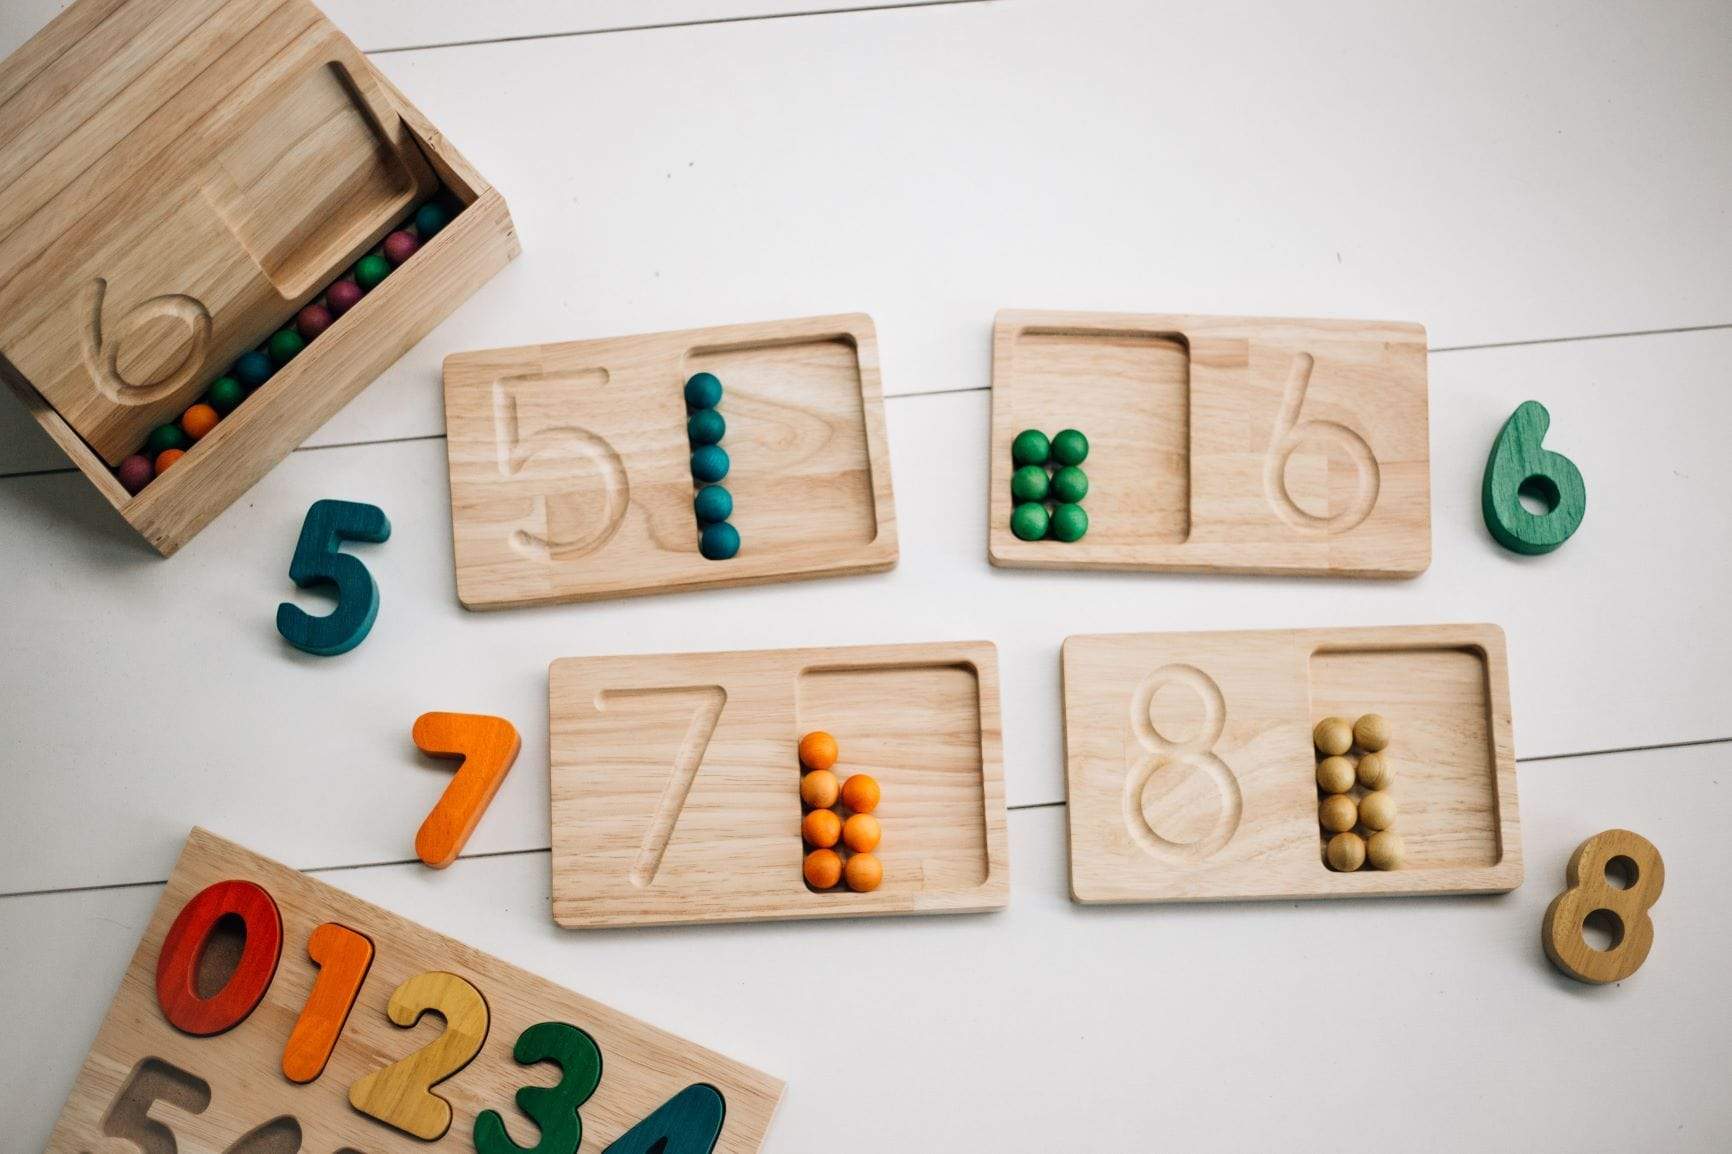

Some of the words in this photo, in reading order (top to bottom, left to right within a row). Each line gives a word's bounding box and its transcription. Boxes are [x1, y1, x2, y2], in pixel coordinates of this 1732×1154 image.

[490, 367, 632, 562] 5
[1262, 351, 1381, 535] 6
[1482, 400, 1586, 556] 6
[276, 499, 391, 656] 5
[412, 711, 522, 870] 7
[592, 686, 729, 888] 7
[1122, 662, 1244, 866] 8
[1542, 828, 1666, 985] 8
[155, 879, 284, 1037] 0
[282, 922, 375, 1084] 1
[348, 971, 490, 1141] 2
[473, 1021, 603, 1154] 3
